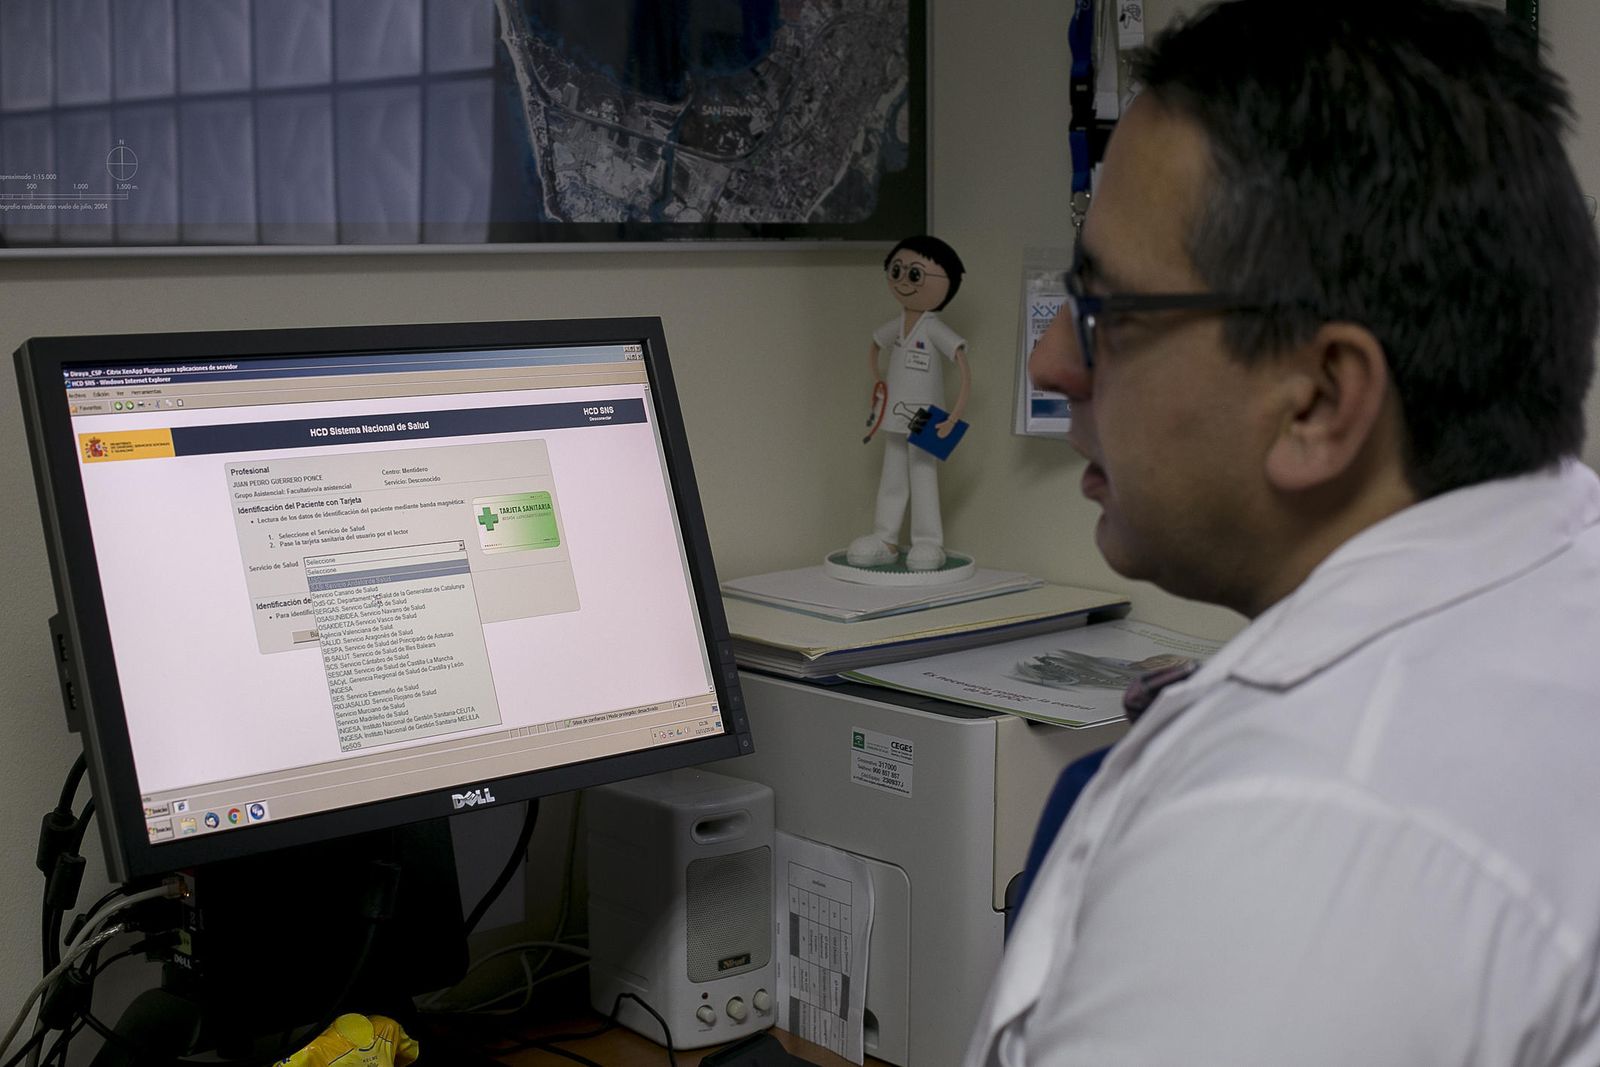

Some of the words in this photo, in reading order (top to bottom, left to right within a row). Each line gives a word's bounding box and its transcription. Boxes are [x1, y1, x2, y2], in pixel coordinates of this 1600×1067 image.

[310, 427, 328, 437] HCD
[330, 426, 361, 435] Sistema
[362, 423, 395, 433] Nacional
[397, 422, 406, 431] de
[408, 421, 430, 430] Salud
[230, 466, 269, 475] Profesional
[238, 504, 283, 514] Identificación
[340, 496, 361, 505] Tarjeta
[499, 506, 522, 514] TARJETA
[521, 502, 551, 511] SANITARIA
[256, 599, 301, 610] Identificación
[891, 741, 912, 753] CEGES
[452, 787, 496, 809] DELL
